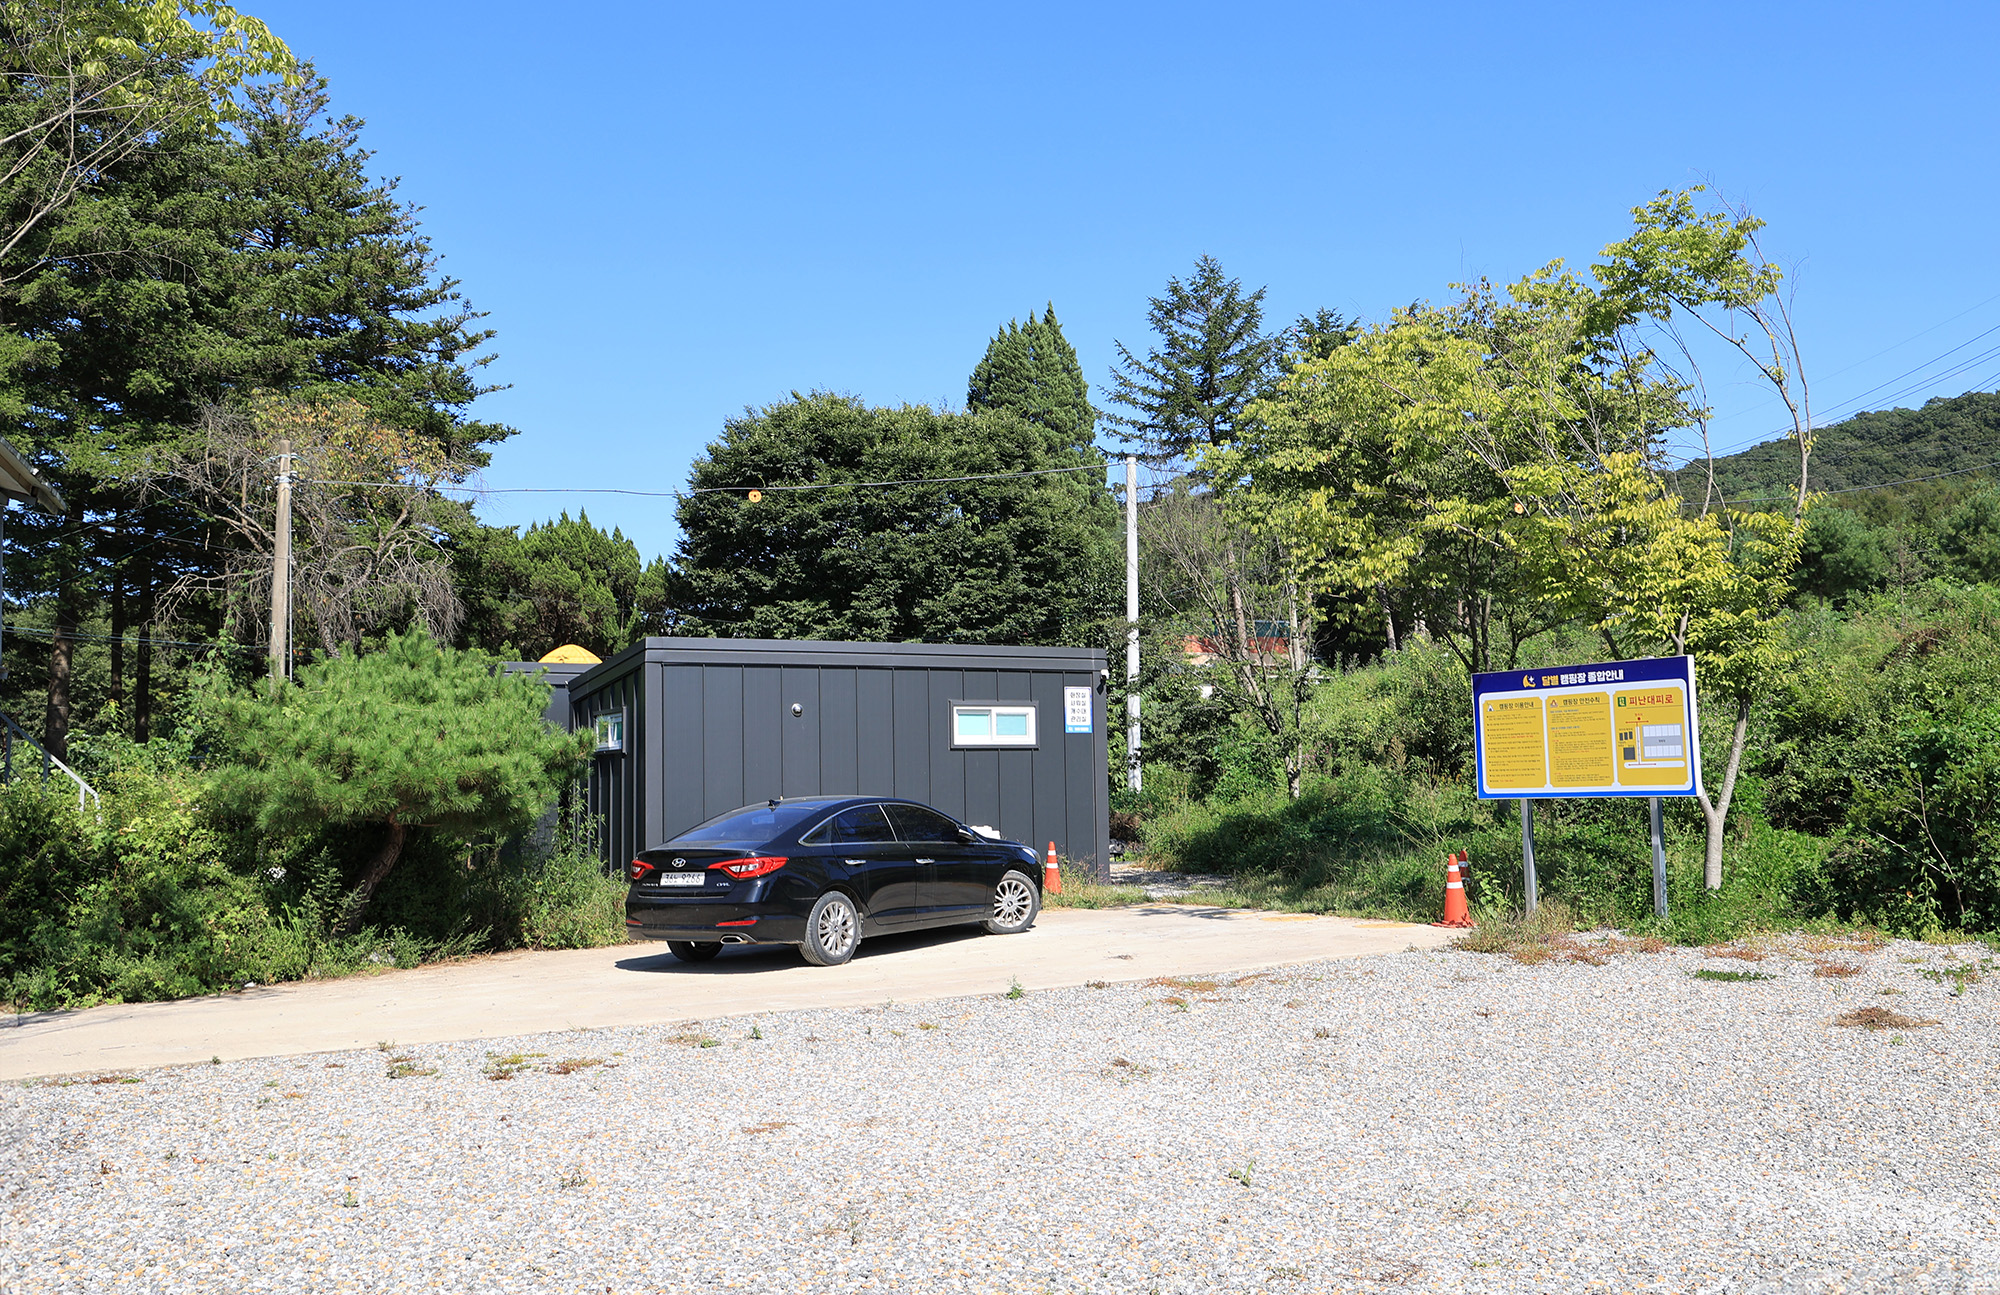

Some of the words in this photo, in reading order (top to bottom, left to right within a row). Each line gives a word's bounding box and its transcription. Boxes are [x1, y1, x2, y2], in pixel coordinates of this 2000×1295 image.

[1541, 675, 1559, 687] 달별
[1560, 672, 1586, 685] 캠핑장
[1588, 669, 1624, 683] 종합안내
[1514, 701, 1534, 709] 이용안내
[1563, 698, 1578, 706] 캠핑장
[1579, 696, 1600, 705] 안전수칙
[1629, 694, 1673, 706] 피난대피로
